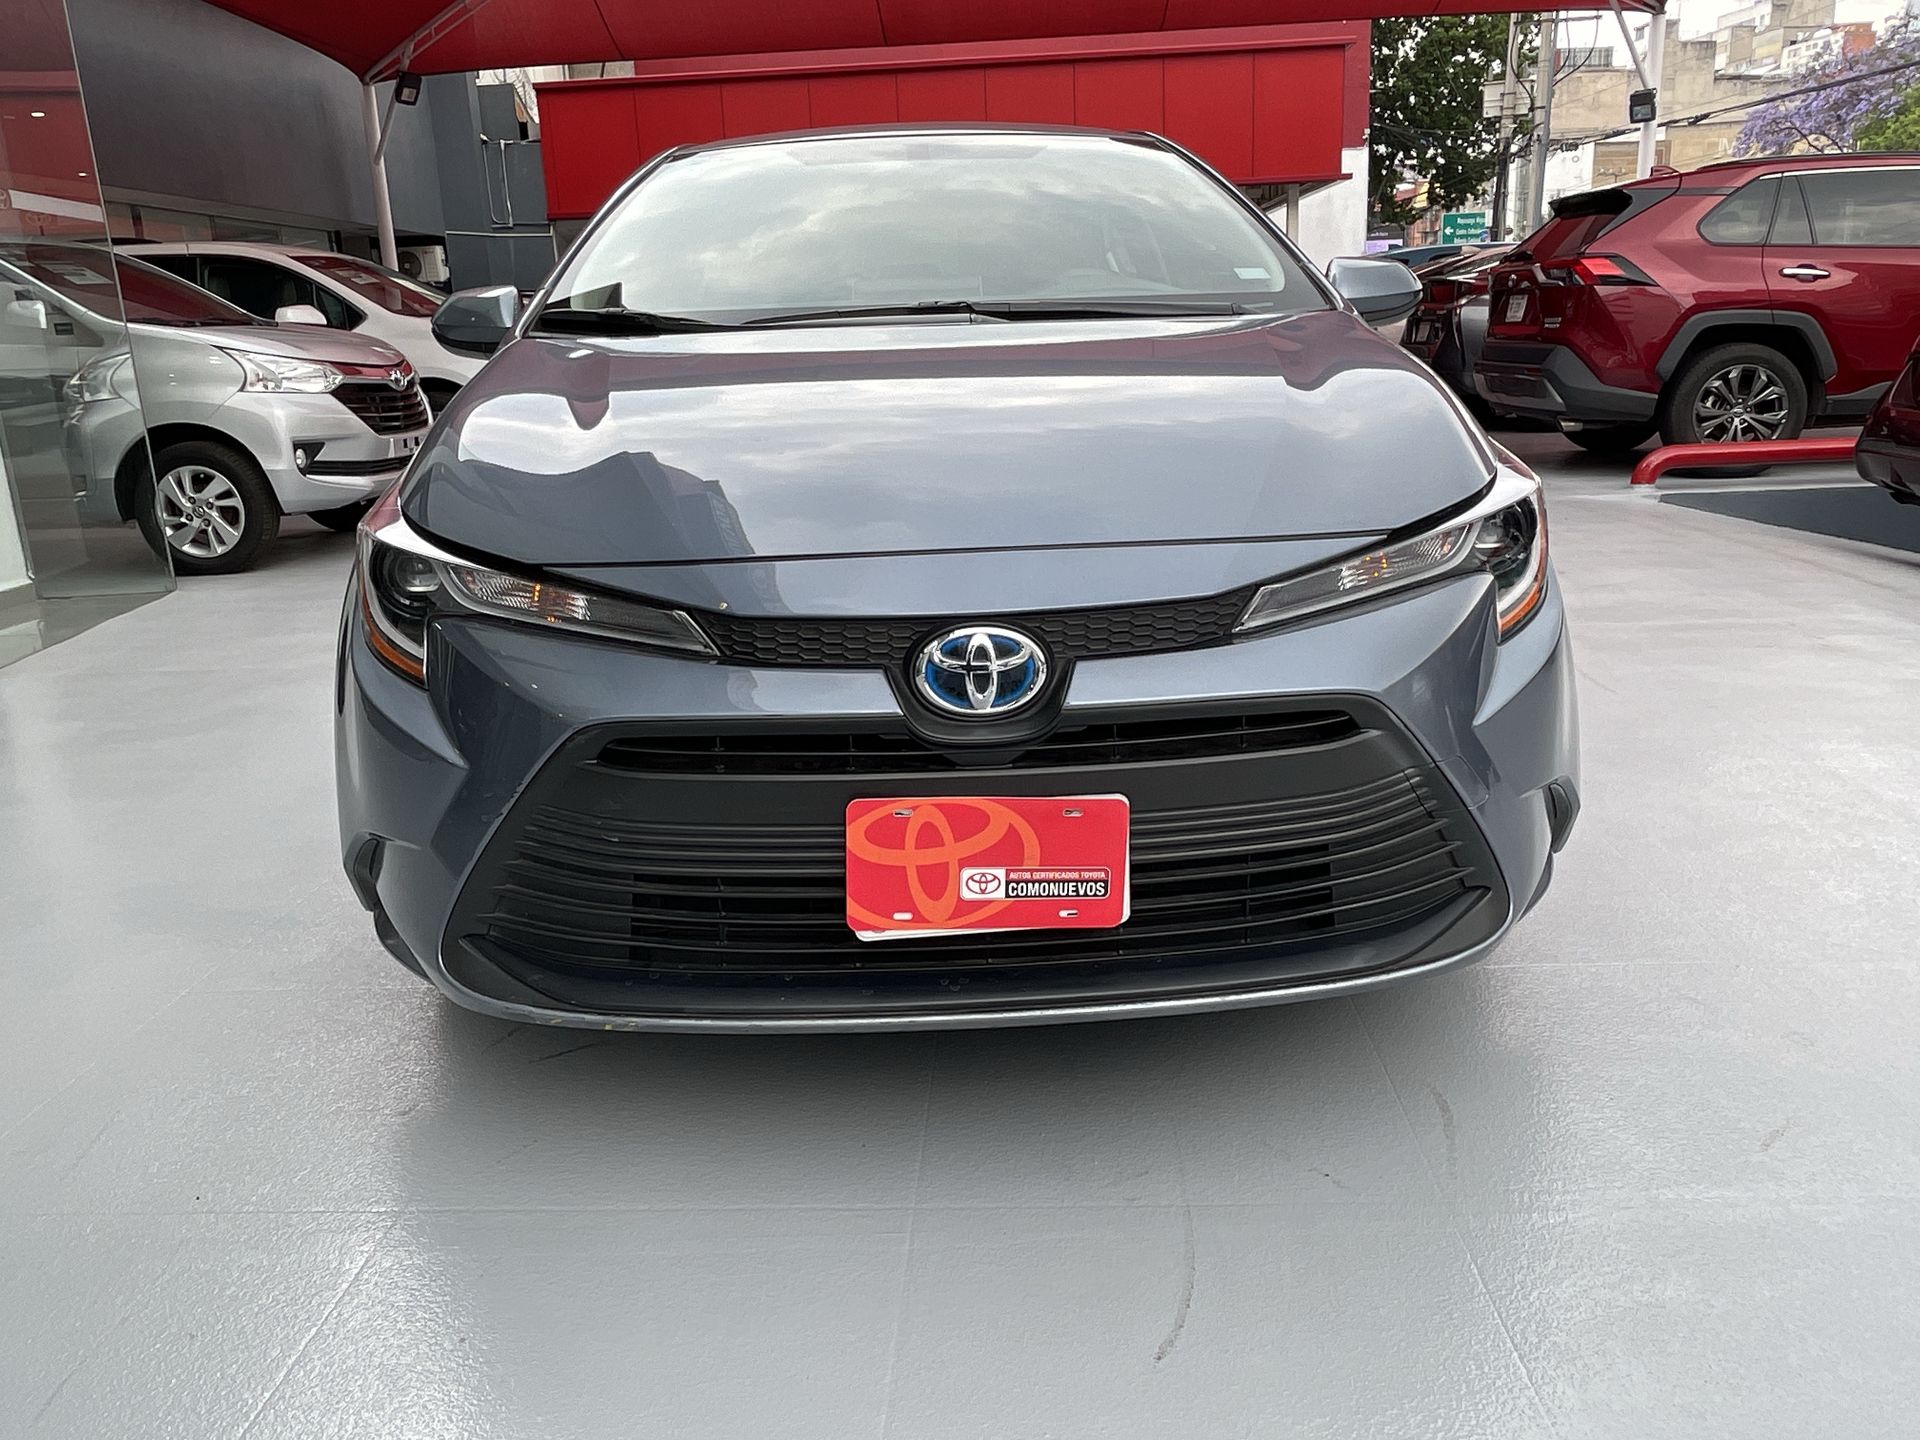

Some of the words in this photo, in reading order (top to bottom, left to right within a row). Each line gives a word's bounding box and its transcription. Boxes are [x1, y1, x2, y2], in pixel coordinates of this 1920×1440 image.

[1032, 871, 1079, 879] CERTIFICADOS
[1081, 871, 1105, 879] TOYOTA
[1008, 882, 1105, 896] COMONUEVOS
